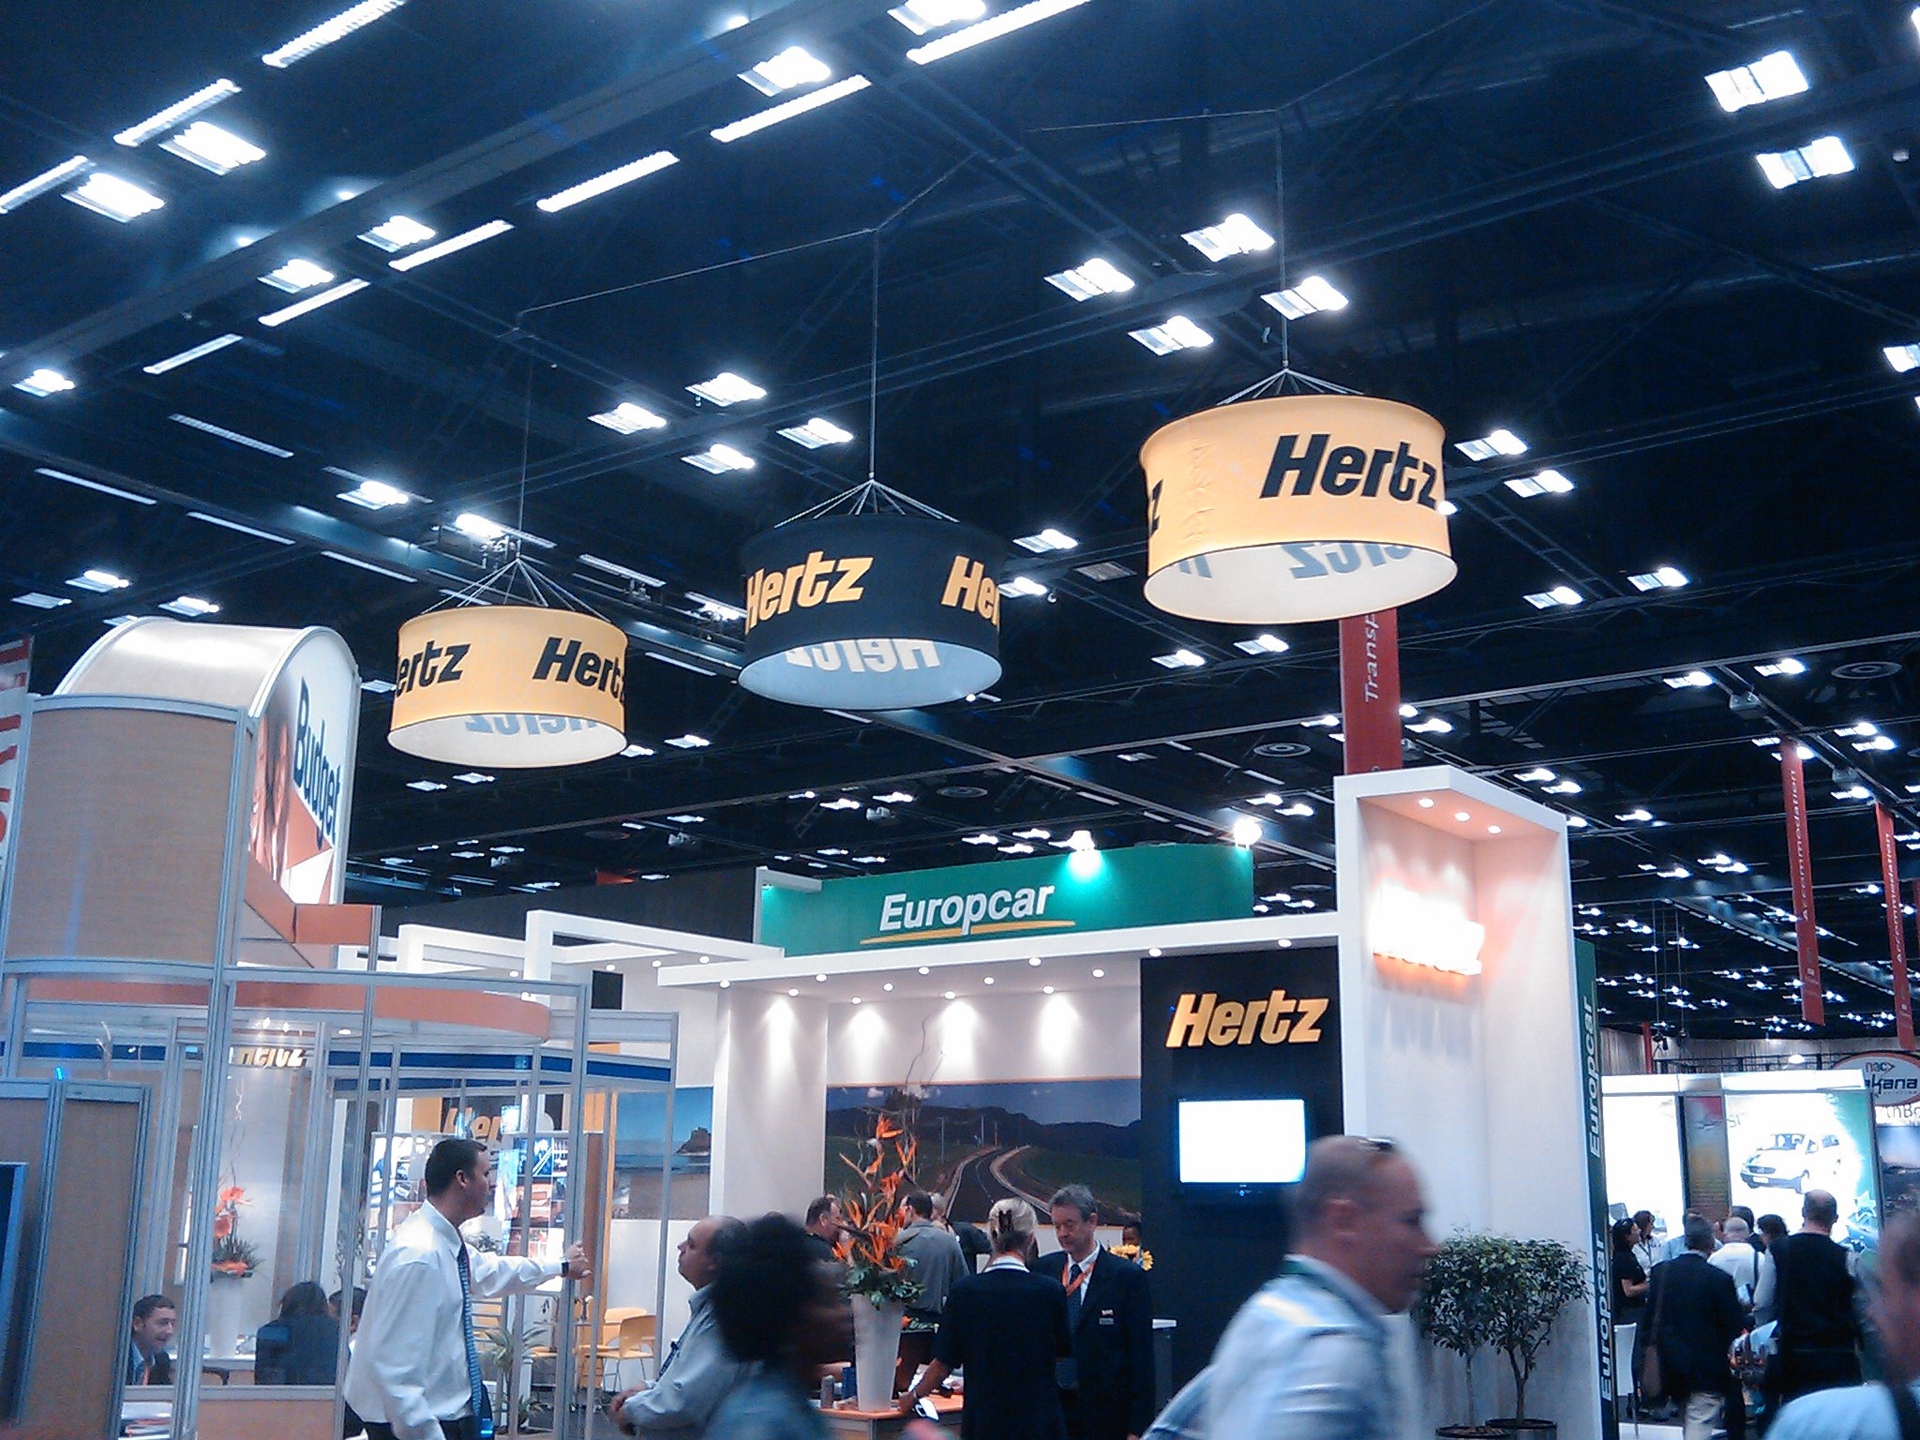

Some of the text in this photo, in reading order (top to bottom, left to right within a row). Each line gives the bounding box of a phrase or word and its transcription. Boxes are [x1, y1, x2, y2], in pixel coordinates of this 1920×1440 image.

[1259, 433, 1438, 511] Hertz
[745, 550, 874, 635] Hertz
[293, 676, 341, 850] Budget
[879, 885, 1055, 936] Europcar
[1165, 989, 1329, 1048] Hertz
[1584, 996, 1601, 1158] Europcar
[1595, 1233, 1612, 1401] Europcar
